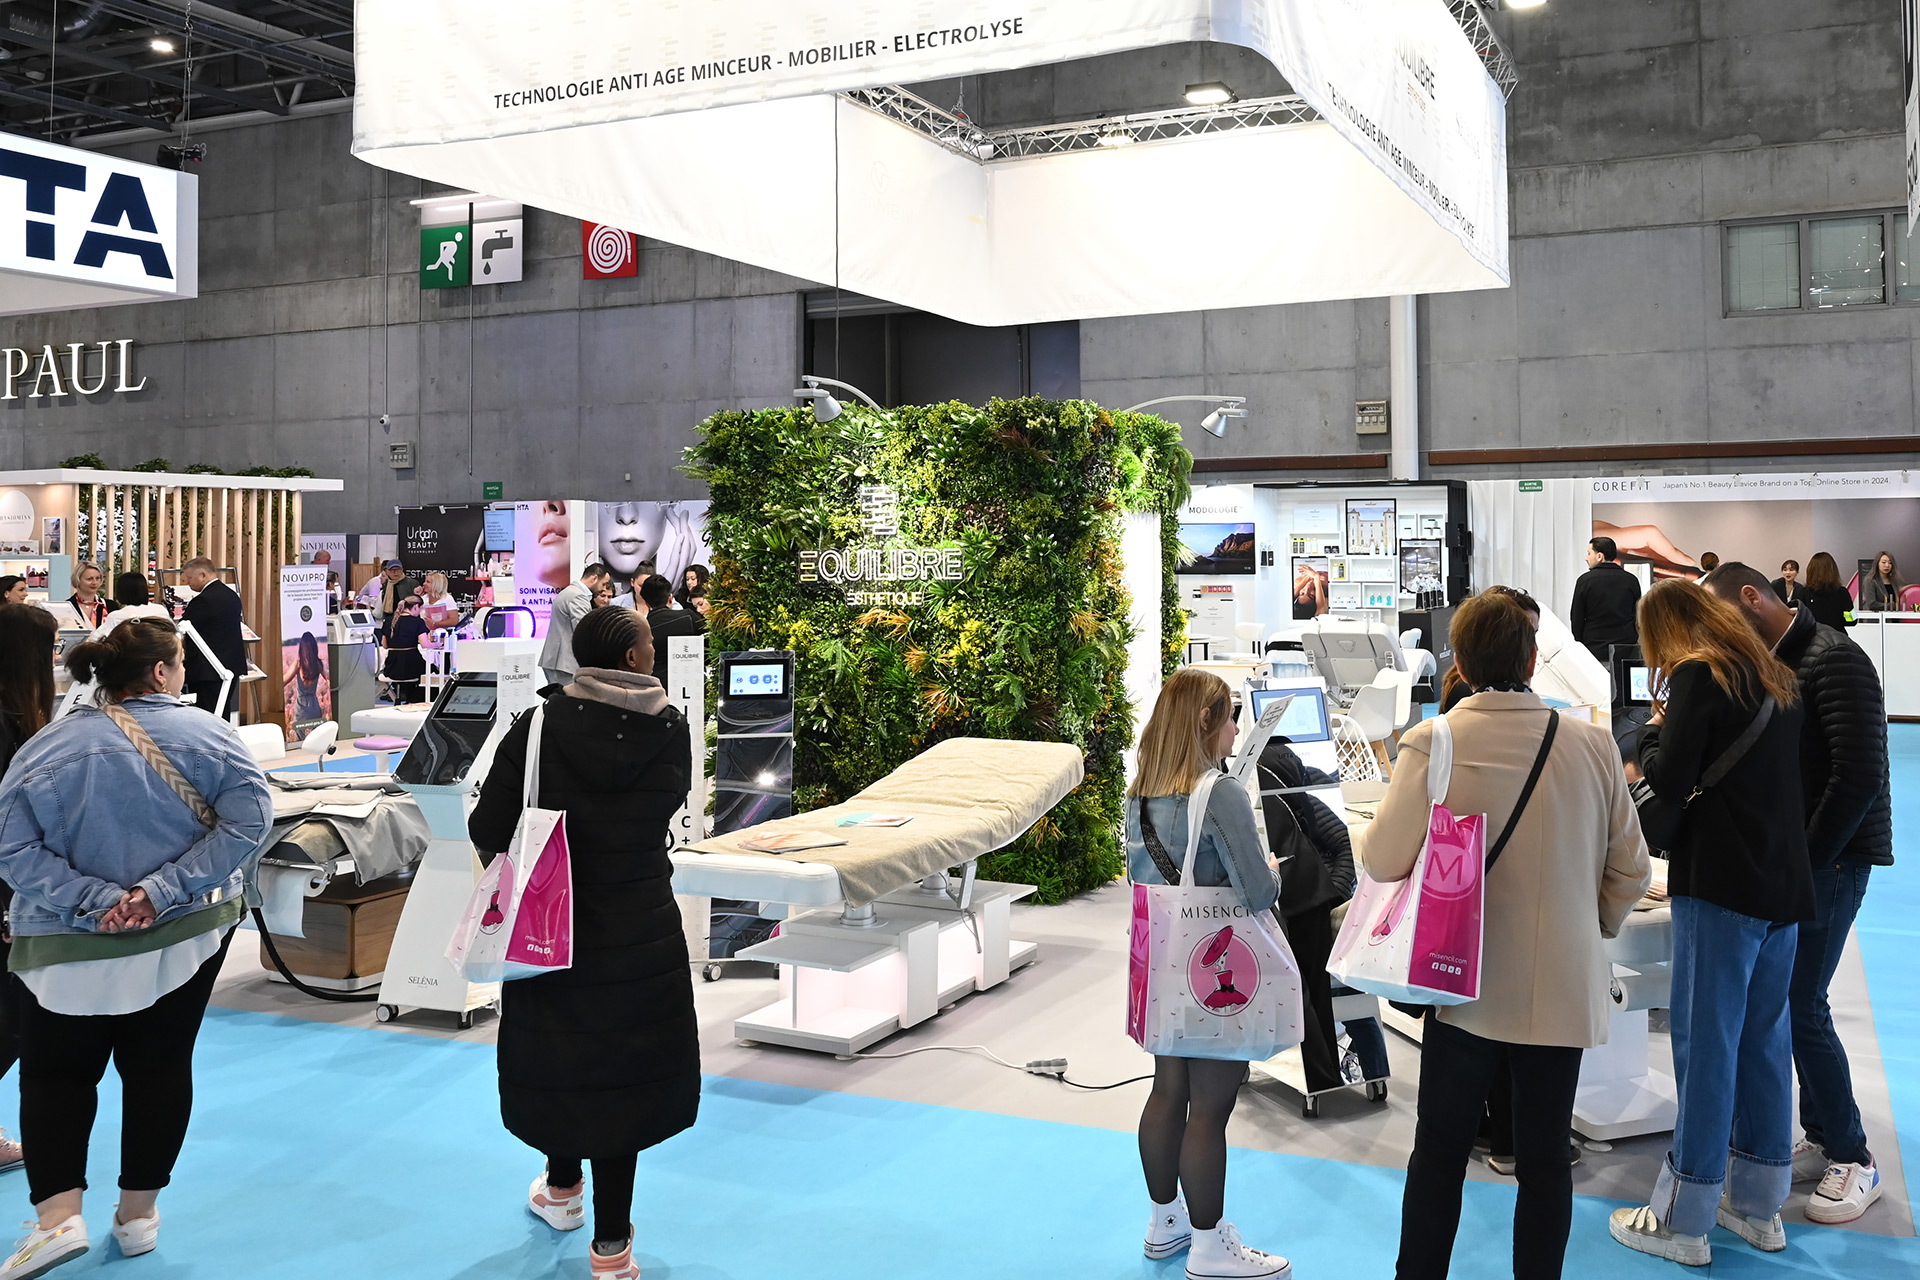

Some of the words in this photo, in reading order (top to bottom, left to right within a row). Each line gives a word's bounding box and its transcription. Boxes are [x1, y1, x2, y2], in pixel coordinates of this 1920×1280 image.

[494, 75, 605, 109] TECHNOLOGIE
[608, 72, 649, 93] ANTI
[653, 66, 686, 87] AGE
[691, 53, 773, 81] MINCEUR
[788, 38, 877, 68] MOBILIER
[893, 16, 1024, 54] ELECTROLYSE
[1, 339, 147, 400] PAUL
[1663, 481, 1688, 490] Japan's
[1709, 481, 1733, 489] Beauty
[1800, 479, 1812, 488] Top
[407, 526, 438, 541] Urban
[407, 541, 438, 549] BEAUTY
[800, 548, 963, 584] EQUILIBRE
[282, 573, 326, 583] NOVIPRO
[847, 590, 924, 606] ESTHETIQUE
[1425, 850, 1464, 886] M
[1429, 952, 1468, 965] misencil.com
